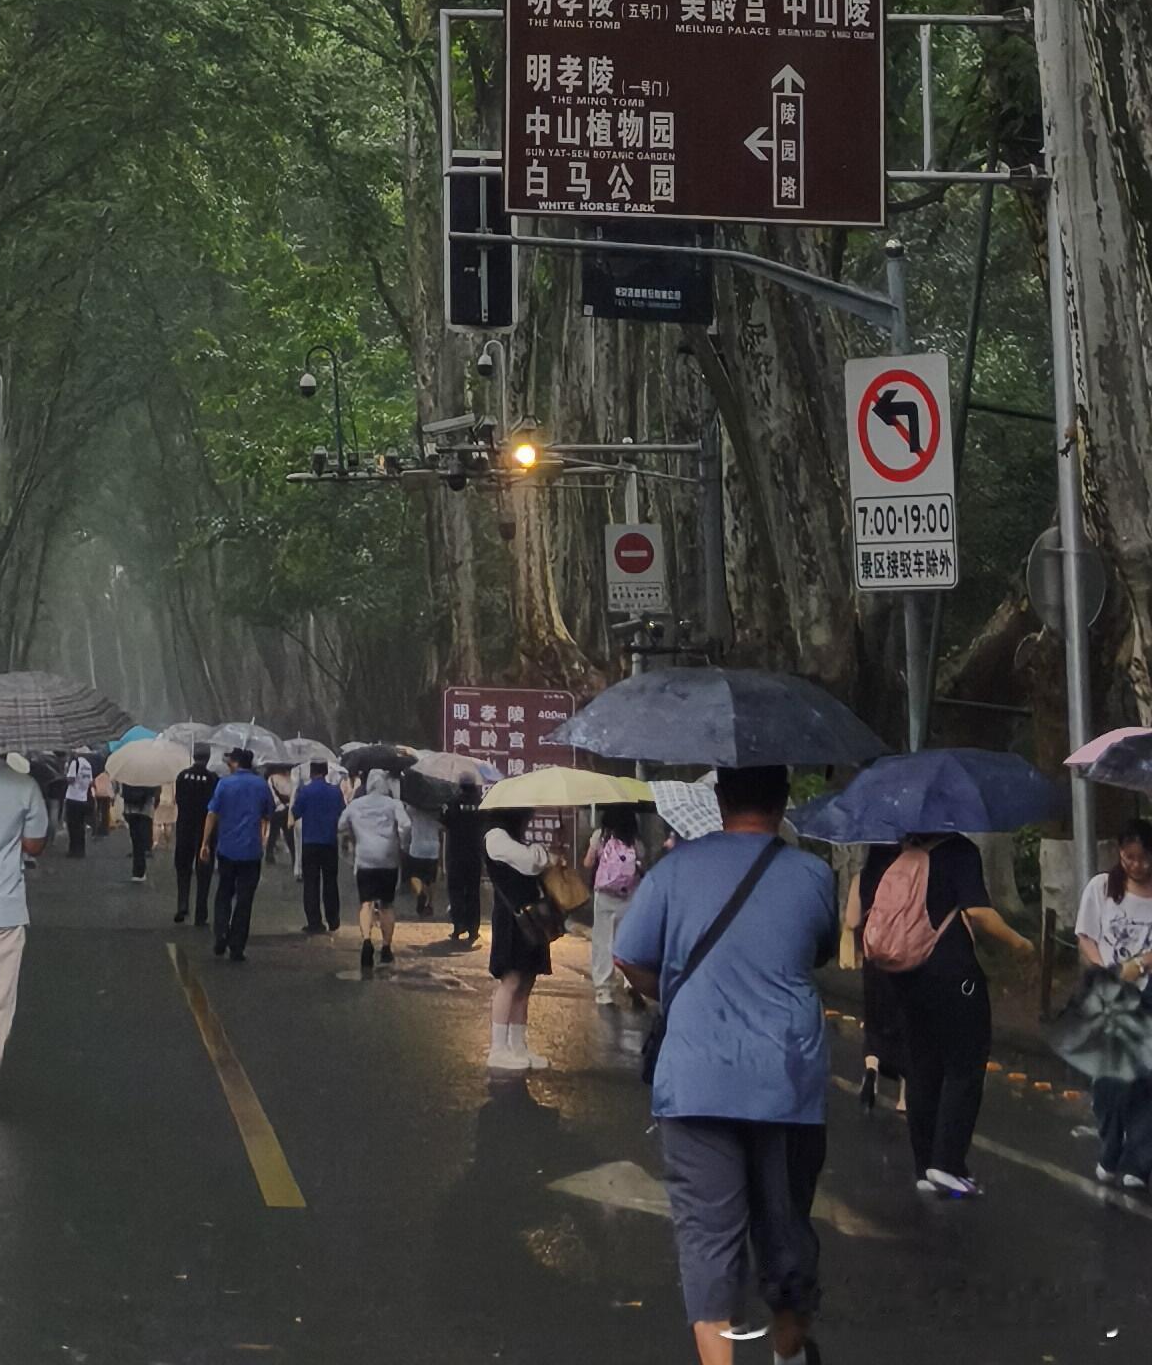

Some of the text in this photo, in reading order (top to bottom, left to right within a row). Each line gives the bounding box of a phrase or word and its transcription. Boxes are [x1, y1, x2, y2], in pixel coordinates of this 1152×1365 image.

[528, 18, 621, 30] THE MING TOMB
[675, 24, 771, 36] MEILING PALACE
[526, 54, 615, 95] 明孝陵
[551, 96, 645, 108] THE MING TOMB
[526, 105, 675, 150] 中山植物园
[525, 148, 545, 157] SUN
[593, 150, 634, 160] BOTANIC
[636, 152, 676, 161] GARDEN
[780, 102, 797, 199] 陵园路
[526, 158, 675, 203] 白马公园
[538, 201, 656, 213] WHITE HORSE PARK
[857, 503, 950, 537] 7:00-19:00
[860, 549, 953, 580] 景区接驳车除外
[537, 709, 568, 720] 400m
